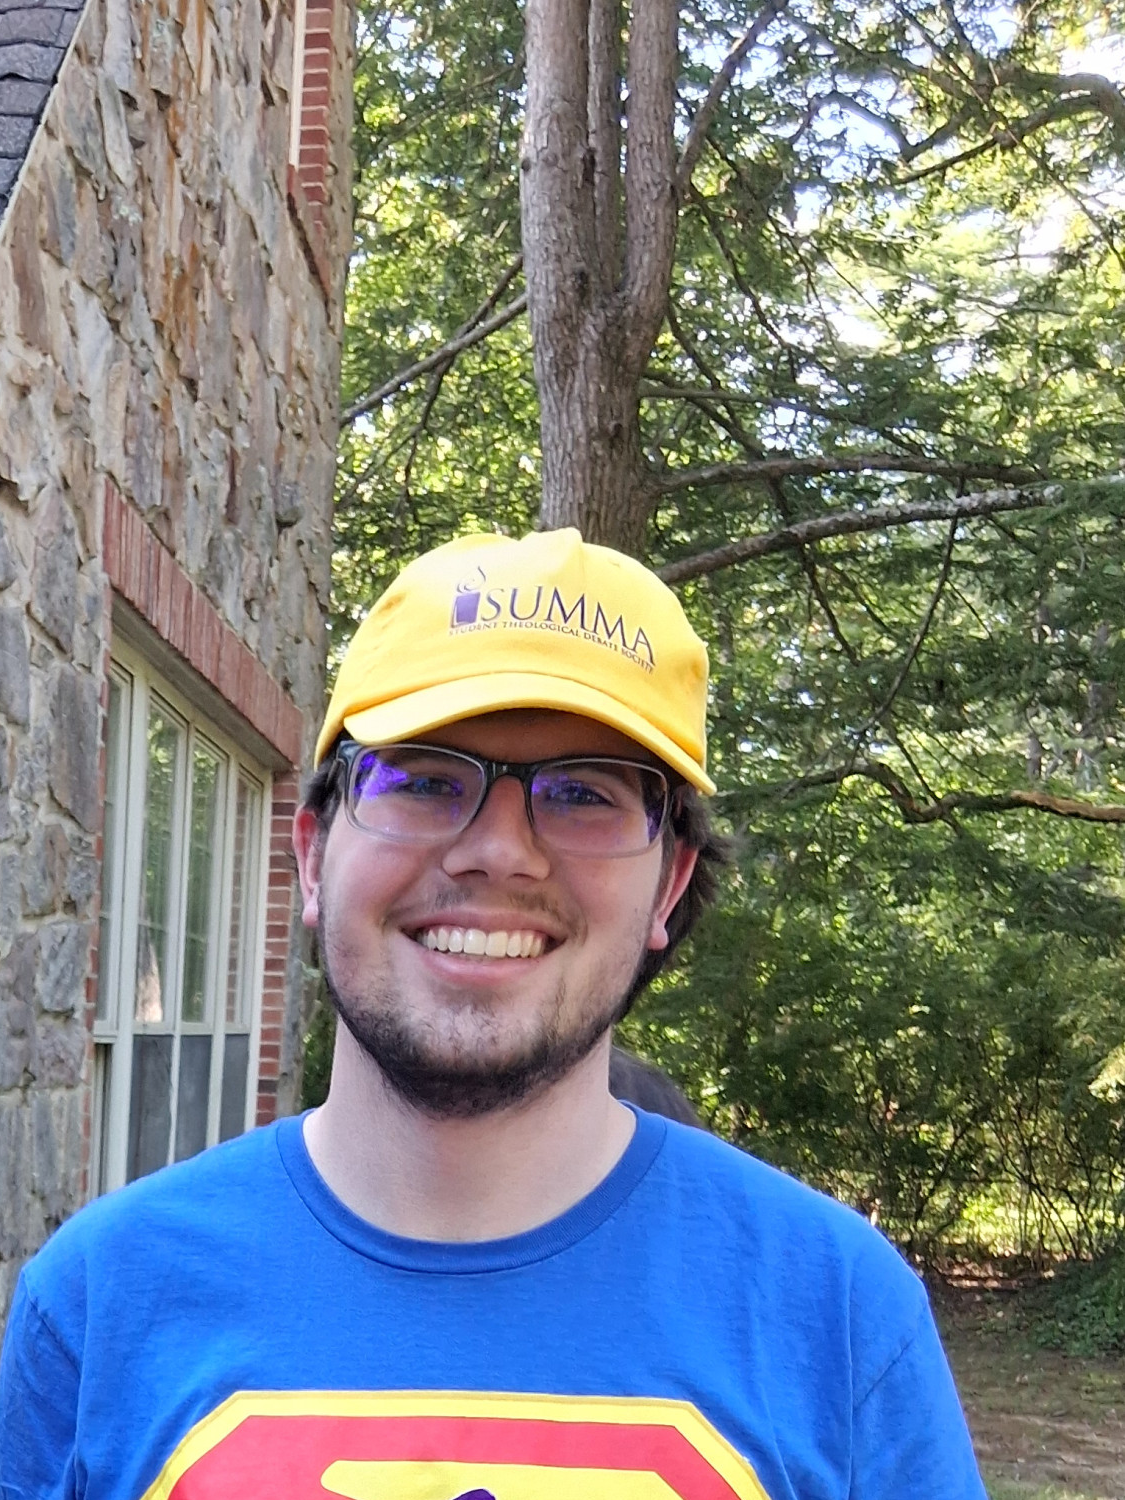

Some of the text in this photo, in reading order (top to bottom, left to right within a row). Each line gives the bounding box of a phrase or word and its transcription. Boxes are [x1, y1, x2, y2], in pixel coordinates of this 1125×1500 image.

[449, 621, 653, 674] STUDENT THEOLOGICAL DEBATE SOCIETY
[480, 585, 656, 667] SUMMA
